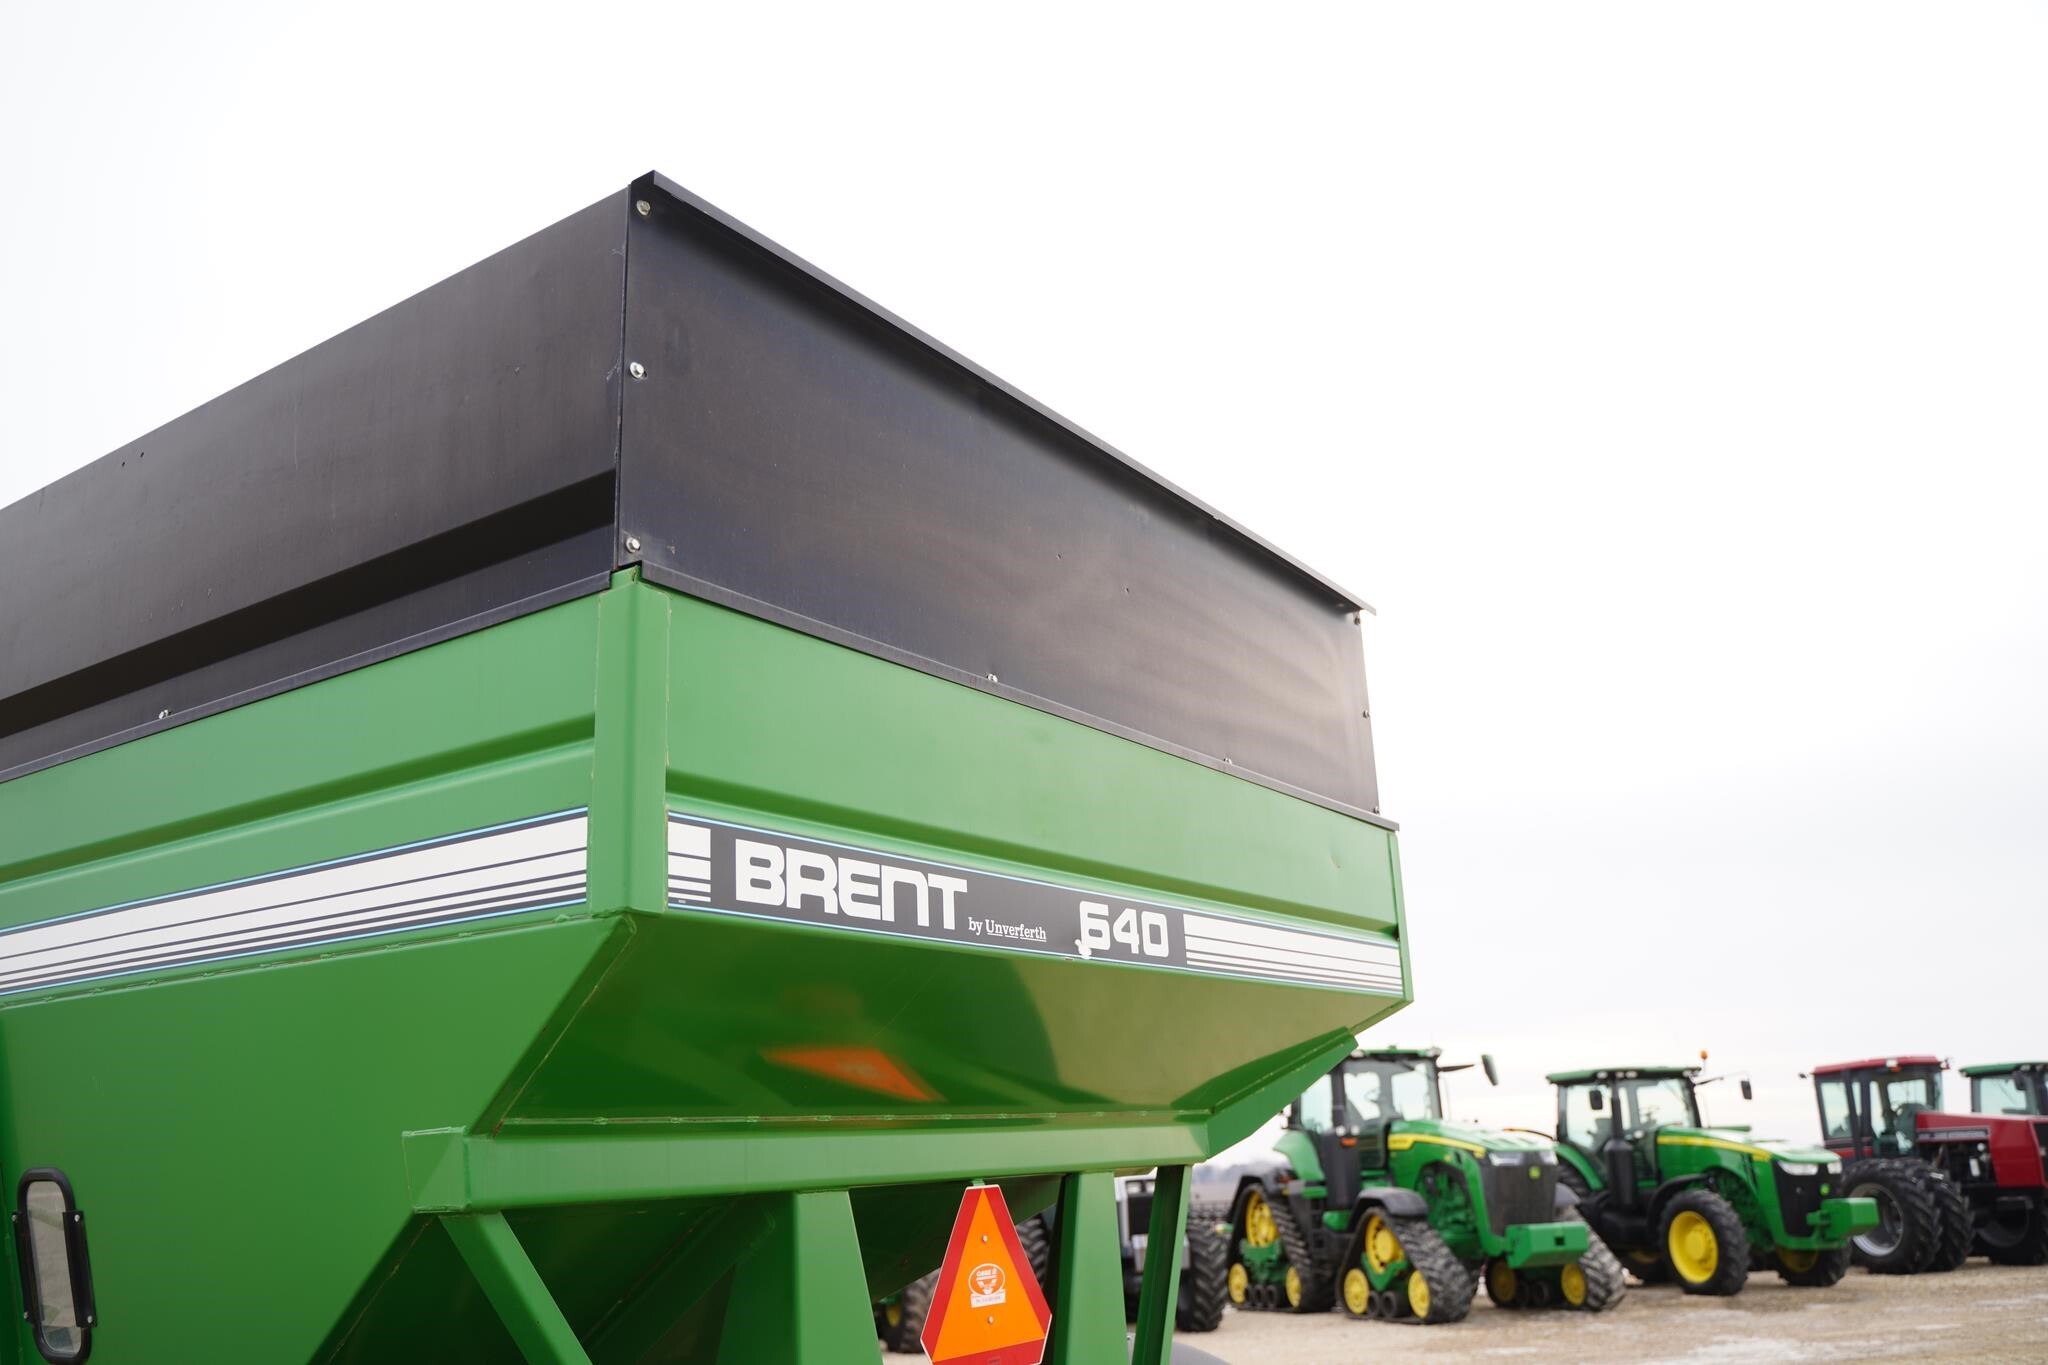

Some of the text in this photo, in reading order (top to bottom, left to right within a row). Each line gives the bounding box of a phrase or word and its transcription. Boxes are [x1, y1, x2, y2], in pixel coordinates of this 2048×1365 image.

[735, 838, 968, 930] BRENT
[967, 916, 1047, 940] by Unverferth
[1079, 900, 1169, 958] 640
